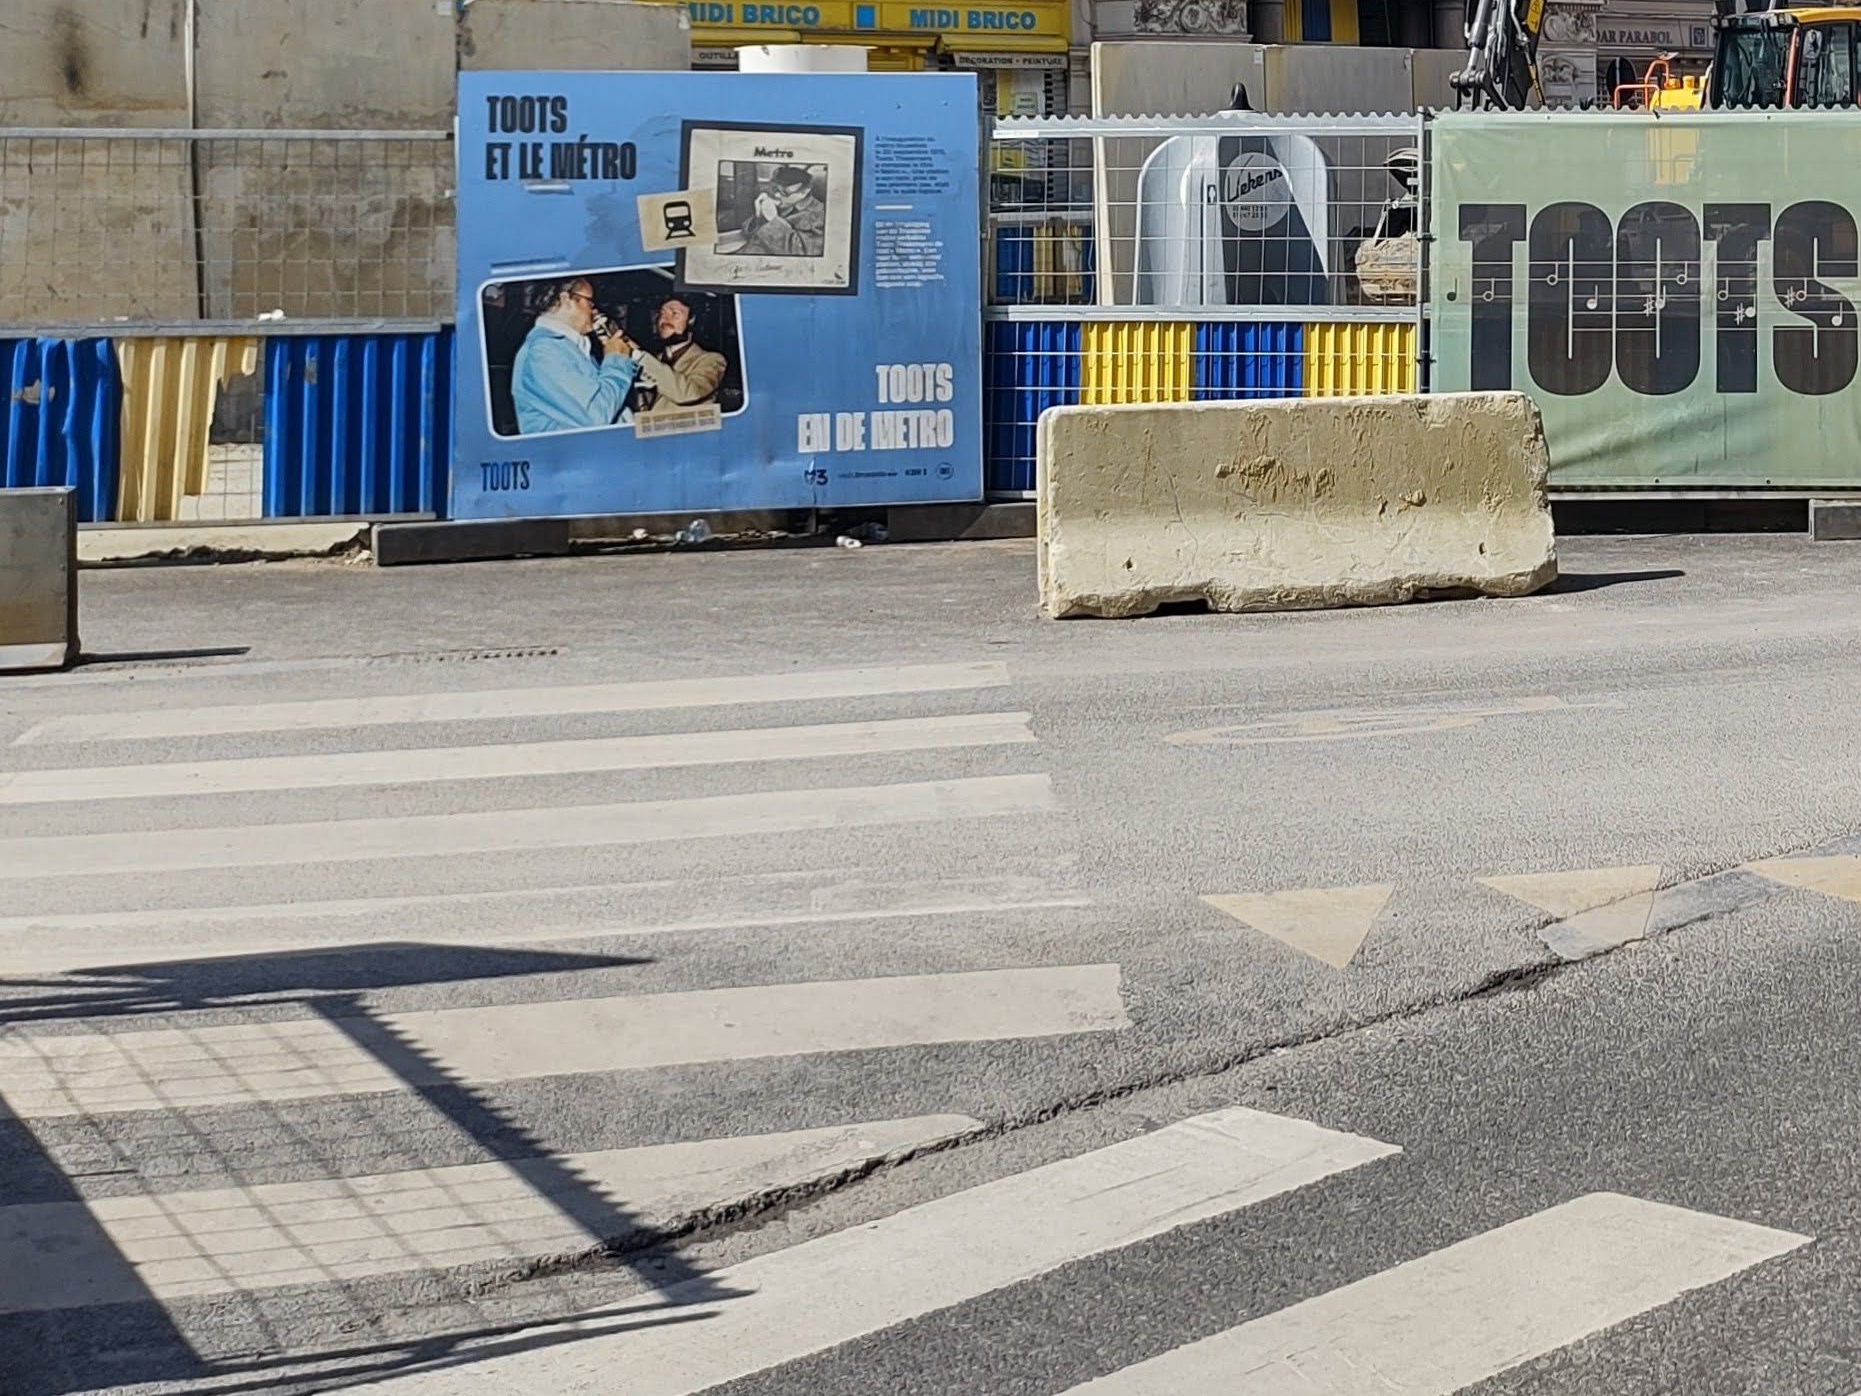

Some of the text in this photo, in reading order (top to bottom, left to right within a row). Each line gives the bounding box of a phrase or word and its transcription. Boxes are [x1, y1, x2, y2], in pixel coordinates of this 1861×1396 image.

[742, 4, 821, 25] BRICO
[909, 9, 1037, 30] MIDI BRICO
[1619, 30, 1673, 44] PARABOL
[1022, 57, 1063, 66] PEINTURE
[486, 95, 568, 133] TOOTS
[486, 134, 637, 180] ET LE MÉTRO
[753, 146, 794, 158] Metro
[1458, 200, 1859, 396] TOOTS
[876, 363, 954, 403] TOOTS
[798, 409, 954, 453] EN DE METRO
[480, 461, 530, 491] TOOTS
